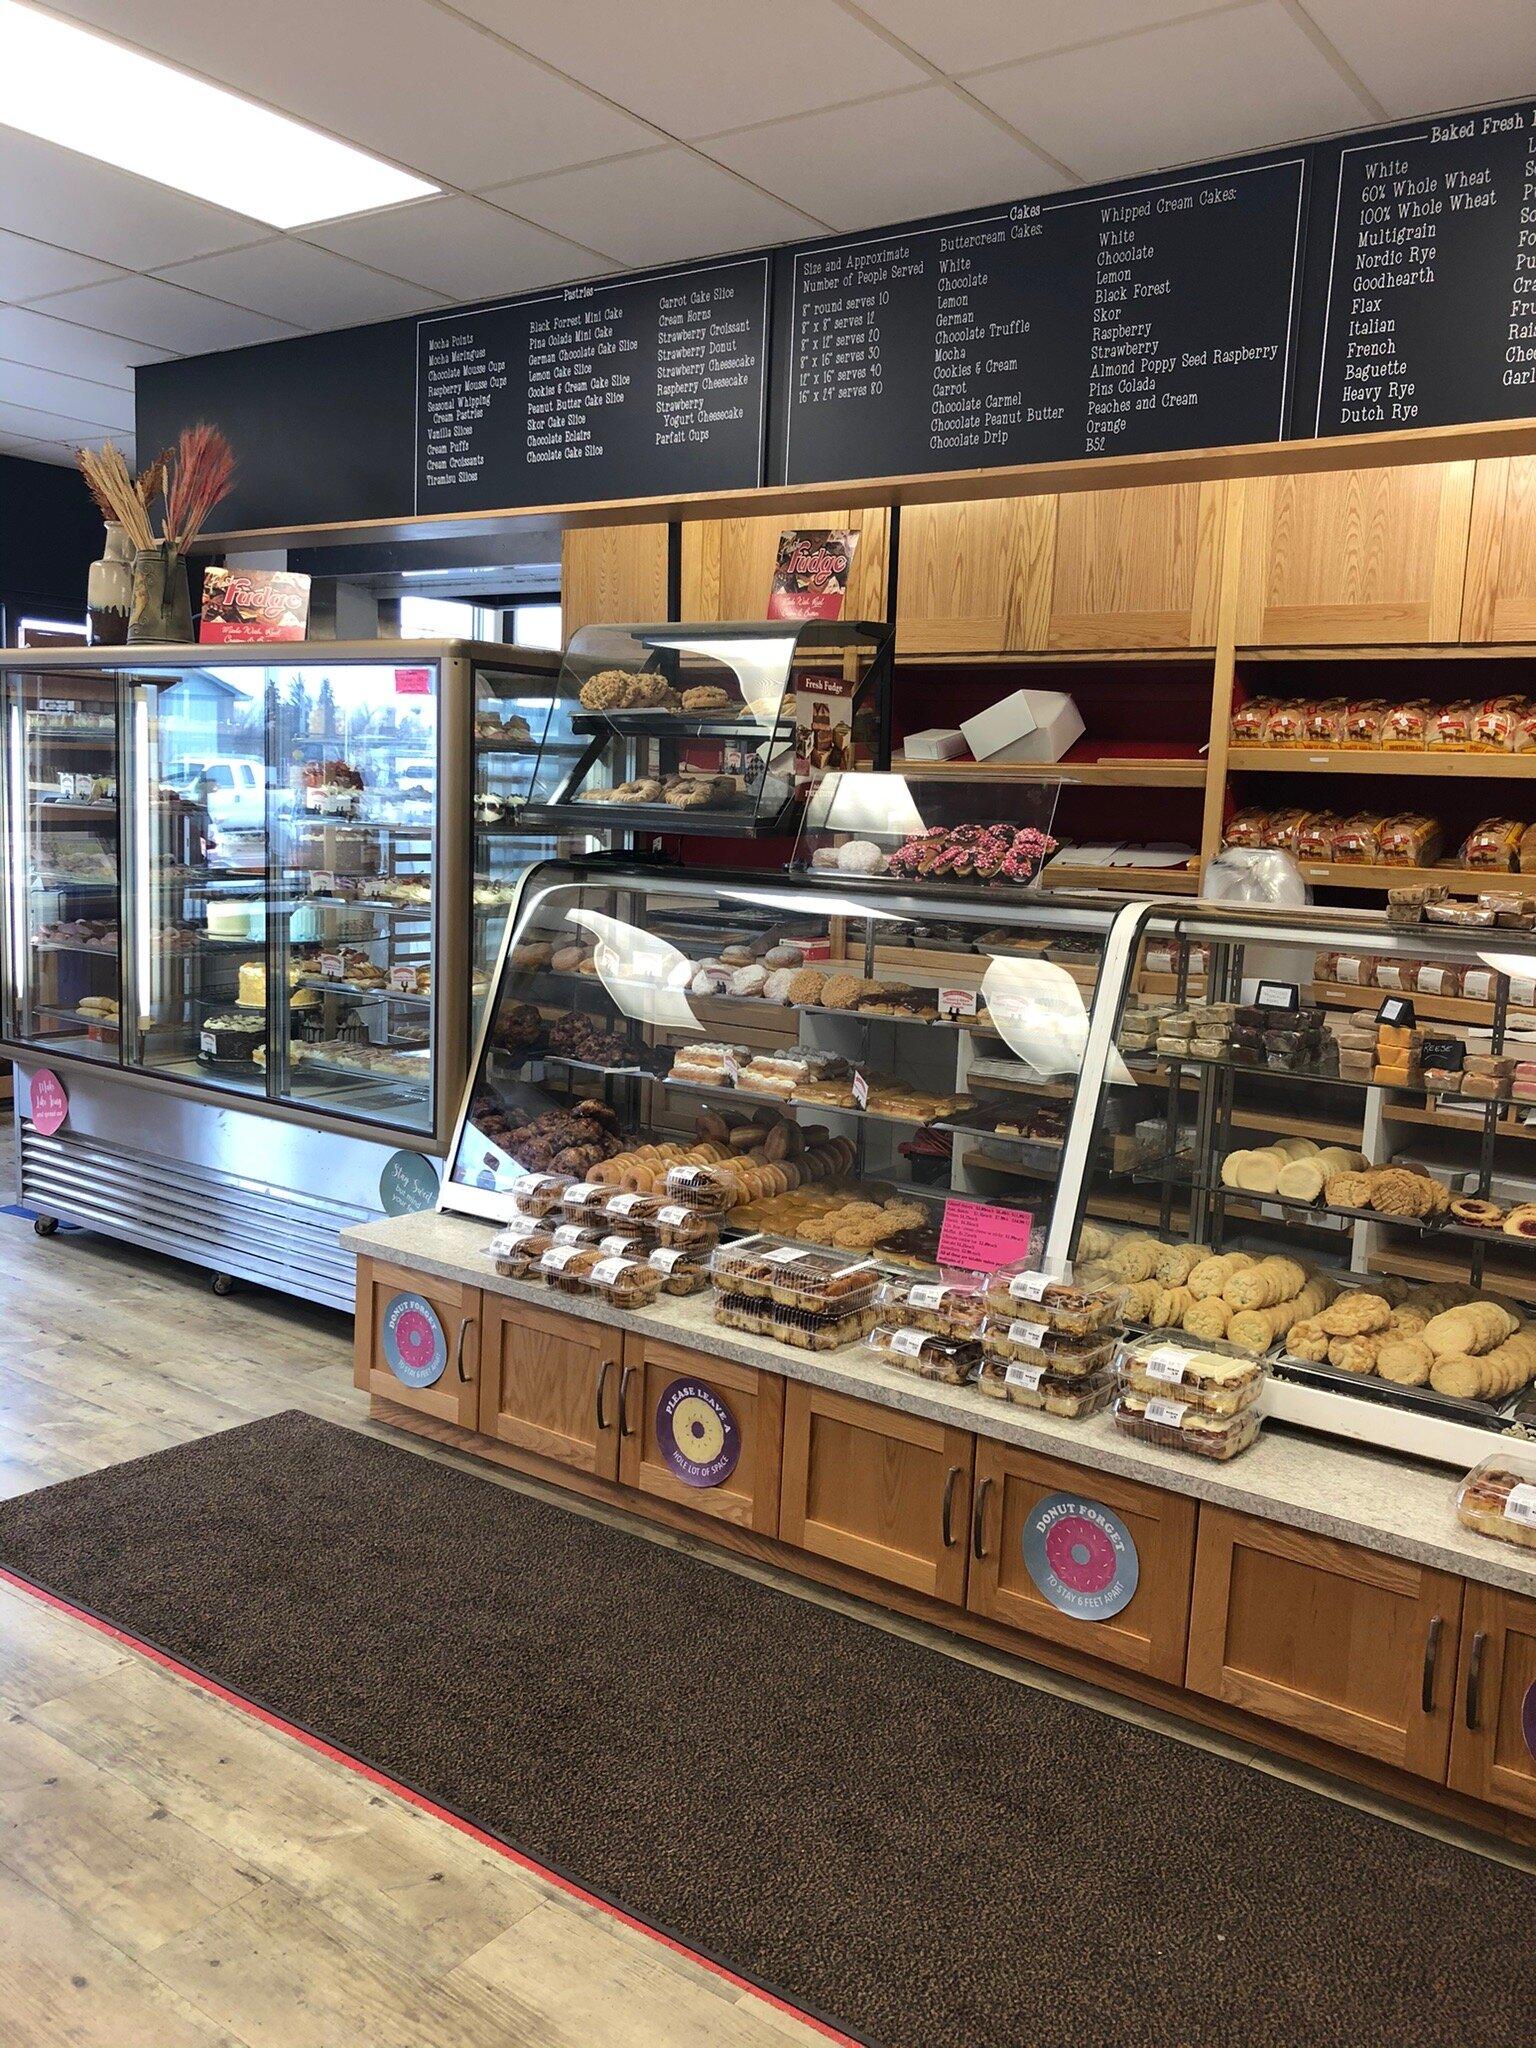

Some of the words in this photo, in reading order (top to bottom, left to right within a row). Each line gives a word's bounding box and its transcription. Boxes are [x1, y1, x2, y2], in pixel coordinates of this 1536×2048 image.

[1431, 120, 1474, 143] Baked
[1481, 113, 1524, 135] Fresh
[1366, 160, 1408, 179] White
[1362, 185, 1385, 202] 60%
[1393, 177, 1437, 197] Whole
[1445, 168, 1491, 189] Wheat
[1010, 205, 1040, 221] Cakes
[1101, 201, 1150, 223] Whipped
[1157, 197, 1193, 213] Cream
[1360, 206, 1390, 225] 100%
[1398, 199, 1442, 218] Whole
[1450, 190, 1497, 211] Wheat
[940, 231, 1005, 252] Buttercream
[1099, 230, 1134, 246] White
[1358, 223, 1436, 247] Multigrain
[804, 263, 822, 275] Size
[825, 257, 841, 272] and
[846, 246, 909, 270] Approximate
[939, 258, 970, 273] White
[1097, 245, 1153, 266] Chocolate
[1356, 250, 1402, 270] Nordic
[1409, 246, 1436, 264] Rye
[803, 277, 839, 293] Number
[843, 273, 853, 286] of
[858, 268, 887, 284] People
[892, 261, 923, 278] Served
[938, 273, 988, 291] Chocolate
[1097, 269, 1131, 284] Lemon
[1353, 266, 1434, 292] Goodhearth
[564, 287, 595, 301] Pastries
[660, 294, 687, 309] Carrot
[691, 291, 710, 304] Cake
[714, 287, 734, 300] Slice
[938, 295, 968, 309] Lemon
[1095, 286, 1127, 304] Black
[1133, 280, 1171, 298] Forest
[814, 298, 842, 315] round
[846, 296, 875, 310] serves
[879, 291, 889, 305] 10
[1351, 298, 1382, 314] Flax
[530, 319, 550, 333] Black
[585, 311, 601, 324] Mini
[605, 307, 623, 320] Cake
[659, 315, 683, 327] Cream
[687, 310, 711, 322] Horns
[936, 312, 973, 327] German
[1094, 308, 1121, 322] Skor
[529, 338, 545, 350] Pina
[548, 333, 572, 346] Colada
[575, 329, 591, 342] Mini
[594, 326, 612, 339] Cake
[658, 328, 706, 344] Strawberry
[710, 319, 750, 336] Croissant
[935, 326, 985, 344] Chocolate
[989, 320, 1030, 337] Truffle
[1093, 323, 1151, 341] Raspberry
[1349, 319, 1395, 336] Italian
[658, 346, 705, 361] Strawberry
[709, 339, 737, 354] Donut
[935, 347, 965, 362] Mocha
[1091, 341, 1159, 359] Strawberry
[1347, 338, 1395, 358] French
[657, 363, 705, 378] Strawberry
[709, 354, 755, 371] Cheesecake
[934, 364, 971, 379] Cookies
[975, 361, 981, 374] &
[986, 359, 1017, 373] Cream
[1090, 360, 1134, 378] Almond
[1141, 358, 1176, 374] Poppy
[1182, 351, 1206, 367] Seed
[1213, 345, 1278, 364] Raspberry
[1345, 360, 1406, 381] Baguette
[529, 371, 551, 382] Lemon
[554, 366, 571, 378] Cake
[574, 364, 592, 375] Slice
[657, 382, 699, 396] Raspberry
[702, 373, 748, 390] Cheesecake
[813, 392, 819, 402] x
[838, 386, 867, 398] serves
[871, 381, 882, 395] 80
[933, 381, 967, 397] Carrot
[1118, 377, 1155, 393] Colada
[1343, 386, 1382, 402] Heavy
[1388, 382, 1415, 400] Rye
[528, 401, 553, 414] Peanut
[556, 398, 582, 411] Butter
[585, 394, 602, 407] Cake
[606, 392, 624, 404] Slice
[656, 398, 704, 413] Strawberry
[932, 398, 981, 414] Chocolate
[986, 392, 1021, 408] Carmel
[1088, 399, 1130, 415] Peaches
[1135, 394, 1155, 410] and
[1162, 393, 1197, 407] Cream
[1341, 405, 1384, 423] Dutch
[1391, 403, 1418, 421] Rye
[527, 419, 545, 430] Skor
[548, 416, 565, 428] Cake
[568, 414, 586, 425] Slice
[664, 412, 694, 428] Yogurt
[698, 407, 743, 422] Cheesecake
[931, 415, 980, 431] Chocolate
[985, 410, 1022, 426] Peanut
[1027, 407, 1064, 421] Butter
[1087, 419, 1126, 434] Orange
[453, 425, 472, 436] Slices
[527, 433, 562, 447] Chocolate
[656, 431, 685, 445] Parfait
[689, 429, 709, 442] Cups
[930, 433, 979, 449] Chocolate
[983, 430, 1008, 445] Drip
[527, 449, 562, 463] Chocolate
[565, 446, 582, 459] Cake
[585, 445, 603, 456] Slice
[1085, 437, 1105, 452] B52
[787, 540, 848, 585] Fudge
[223, 577, 302, 618] Fudge
[805, 678, 823, 690] Fresh
[824, 681, 843, 694] Fudge
[389, 1302, 408, 1329] DONUT
[410, 1301, 437, 1330] FORGET
[666, 1387, 695, 1415] PLEASE
[698, 1389, 727, 1420] LEAVE
[724, 1425, 732, 1434] A
[673, 1451, 687, 1470] HOLE
[688, 1467, 700, 1476] LOT
[702, 1467, 710, 1476] OF
[711, 1455, 729, 1474] SPACE
[1036, 1503, 1075, 1534] DONUT
[1079, 1505, 1125, 1552] FORGET
[1047, 1574, 1057, 1587] TO
[1057, 1585, 1076, 1603] STAY
[1078, 1597, 1083, 1606] 6
[1085, 1597, 1103, 1608] FEET
[1104, 1581, 1124, 1604] APART
